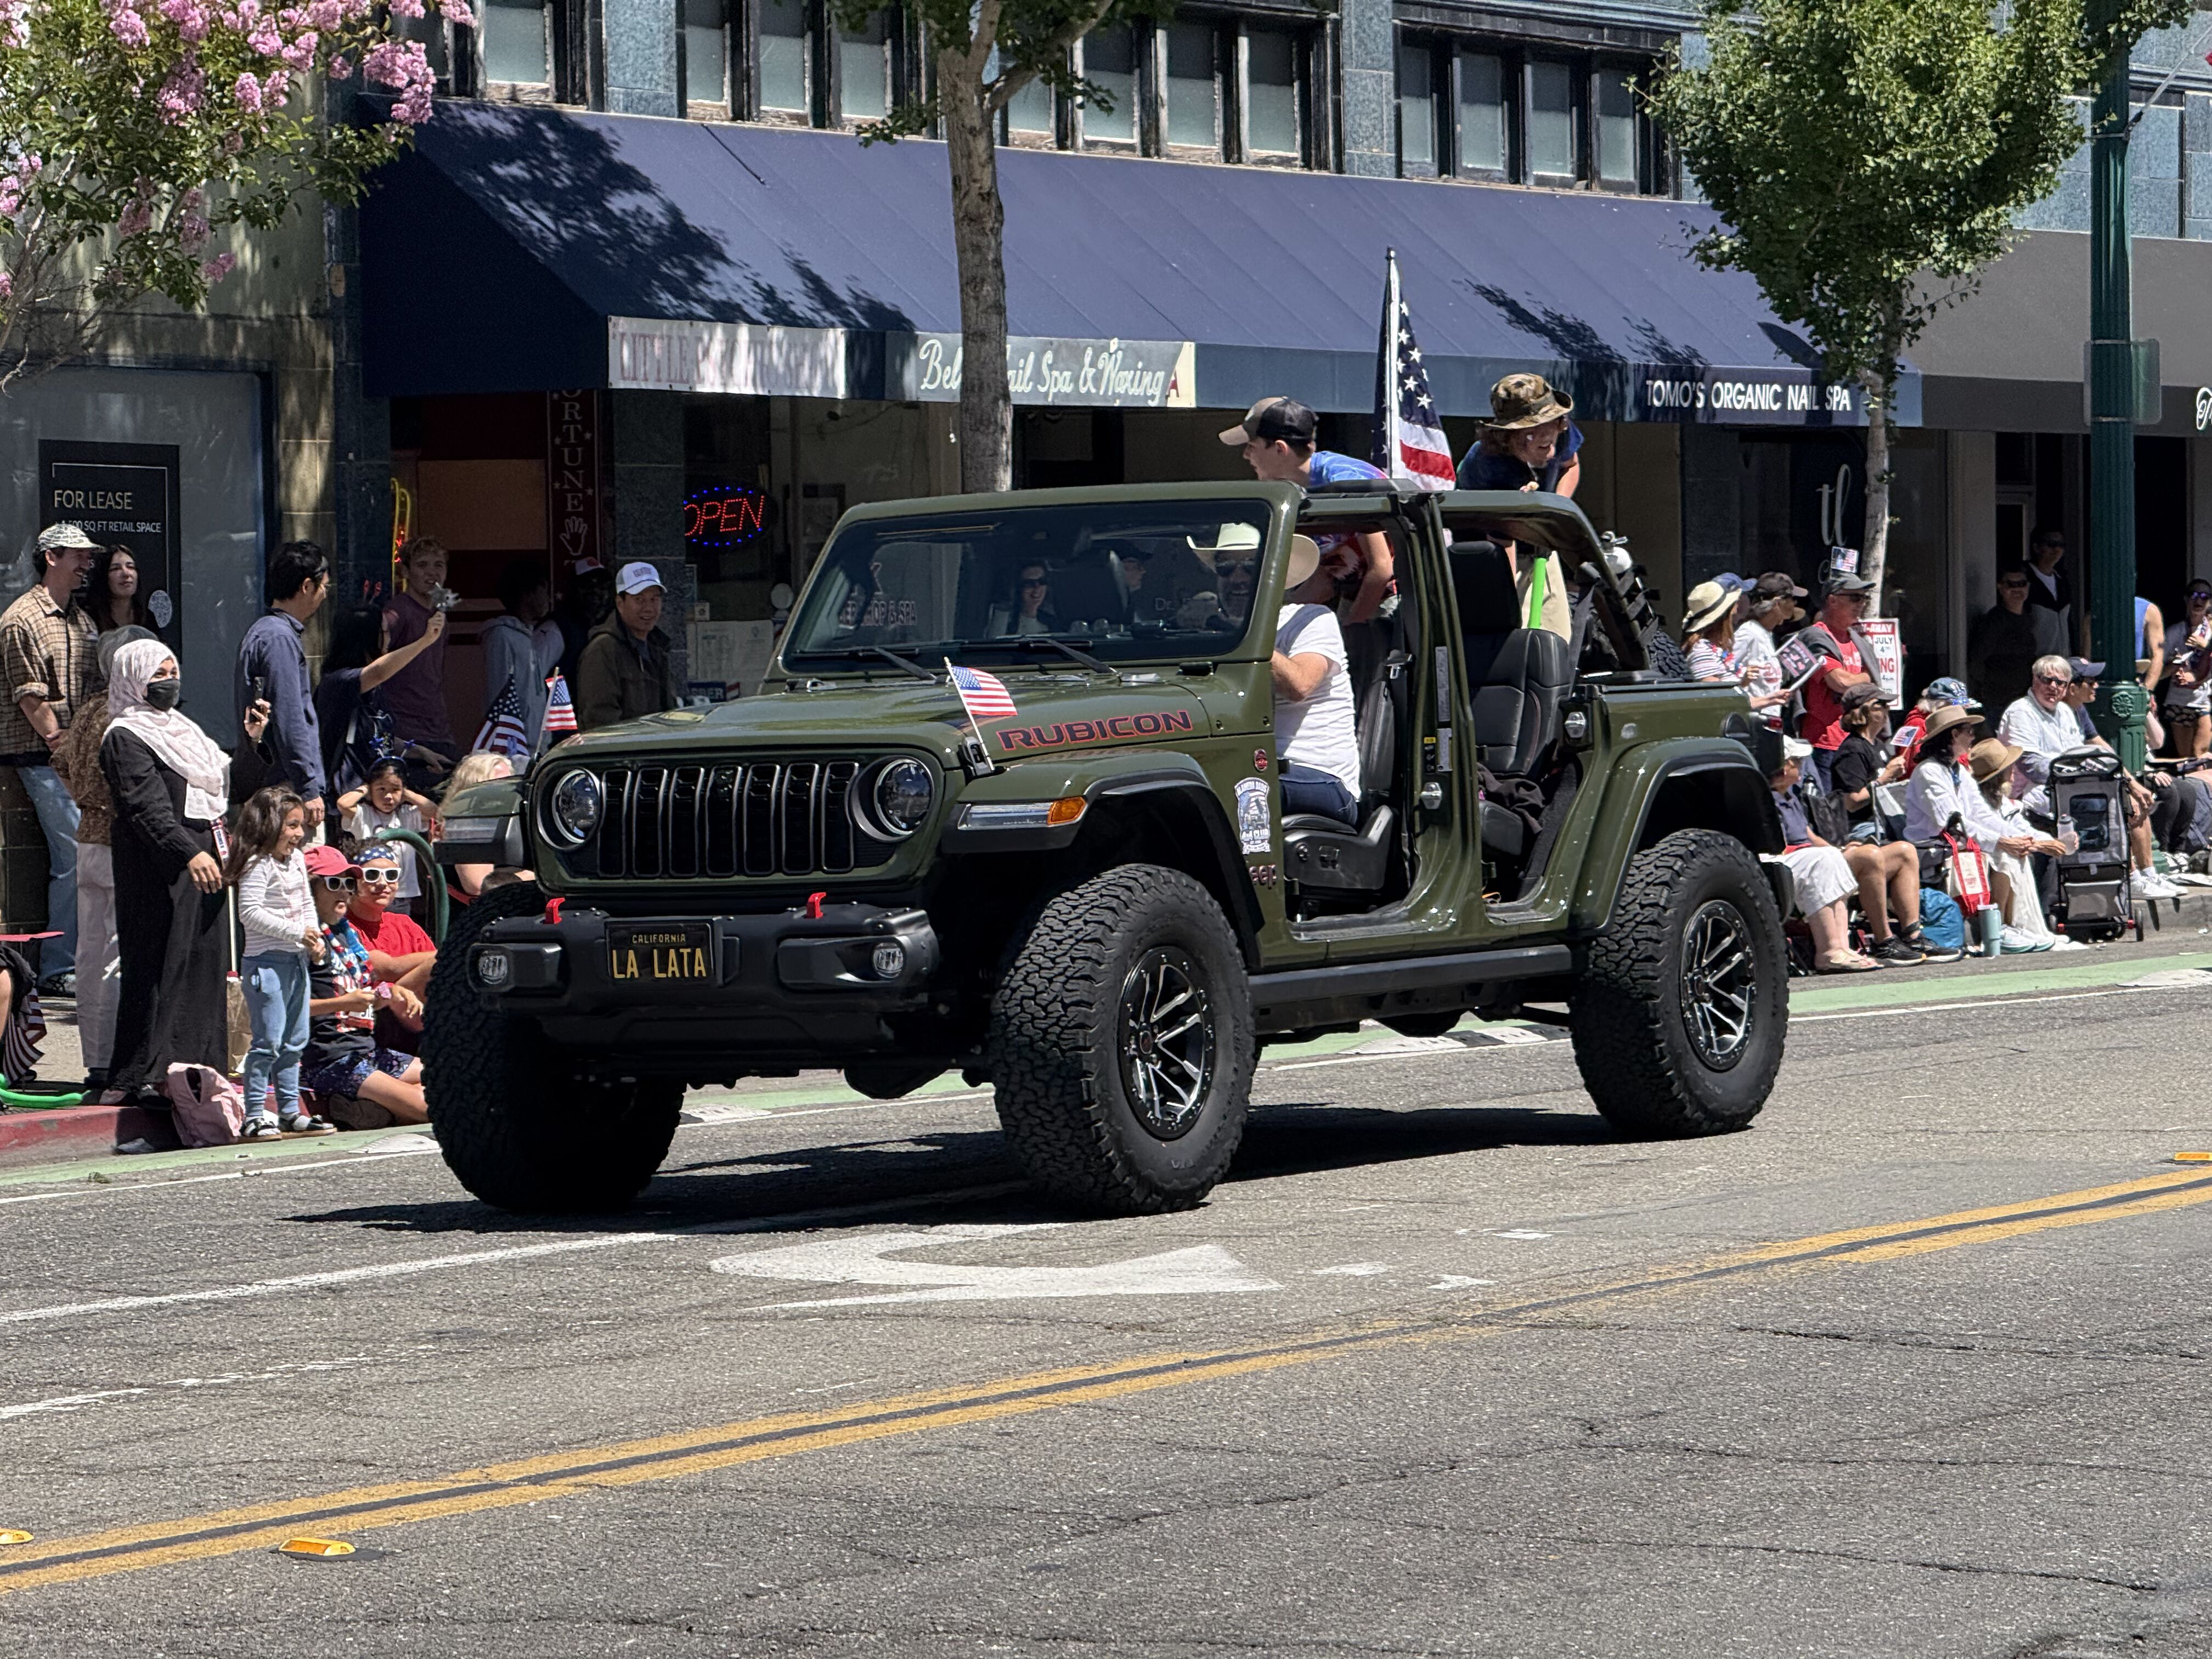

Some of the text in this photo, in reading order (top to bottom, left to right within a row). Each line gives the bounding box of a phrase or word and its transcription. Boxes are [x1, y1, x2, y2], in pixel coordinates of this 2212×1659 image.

[1006, 345, 1035, 393] ail
[1037, 350, 1074, 402] Spa
[1079, 347, 1096, 394] &
[1098, 348, 1165, 406] Waxing
[1646, 380, 1851, 411] TOMO'S ORGANIC NAIL SPA
[54, 490, 133, 510] FOR LEASE
[84, 520, 96, 533] SQ
[97, 521, 106, 532] FT
[109, 521, 136, 533] RETAIL
[136, 522, 161, 533] SPACE
[684, 494, 765, 537] OPEN
[898, 600, 918, 625] SPA
[995, 710, 1193, 751] RUBICON
[1249, 864, 1277, 889] eep
[632, 934, 686, 944] CALIFORNIA
[612, 947, 707, 979] LA LATA
